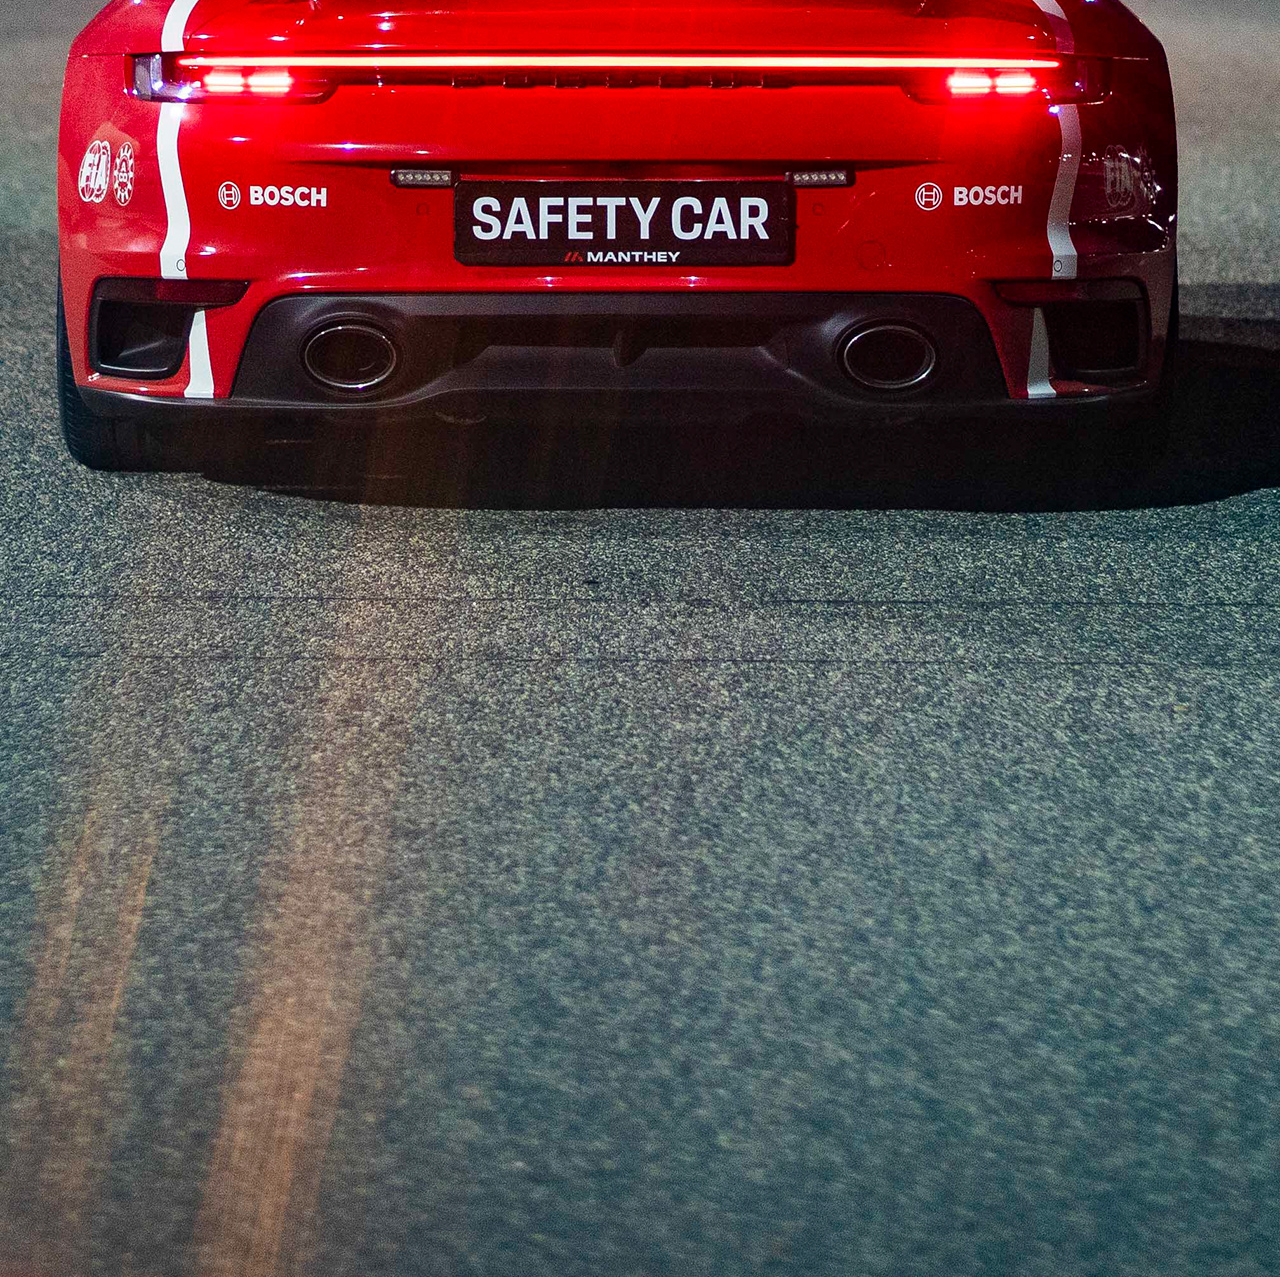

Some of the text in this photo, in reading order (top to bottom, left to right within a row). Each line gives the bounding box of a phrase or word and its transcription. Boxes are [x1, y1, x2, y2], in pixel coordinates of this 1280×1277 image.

[249, 185, 328, 208] BOSCH
[953, 185, 1023, 206] BOSCH
[472, 196, 770, 241] SAFETY CAR
[586, 251, 681, 263] MANTHEY
